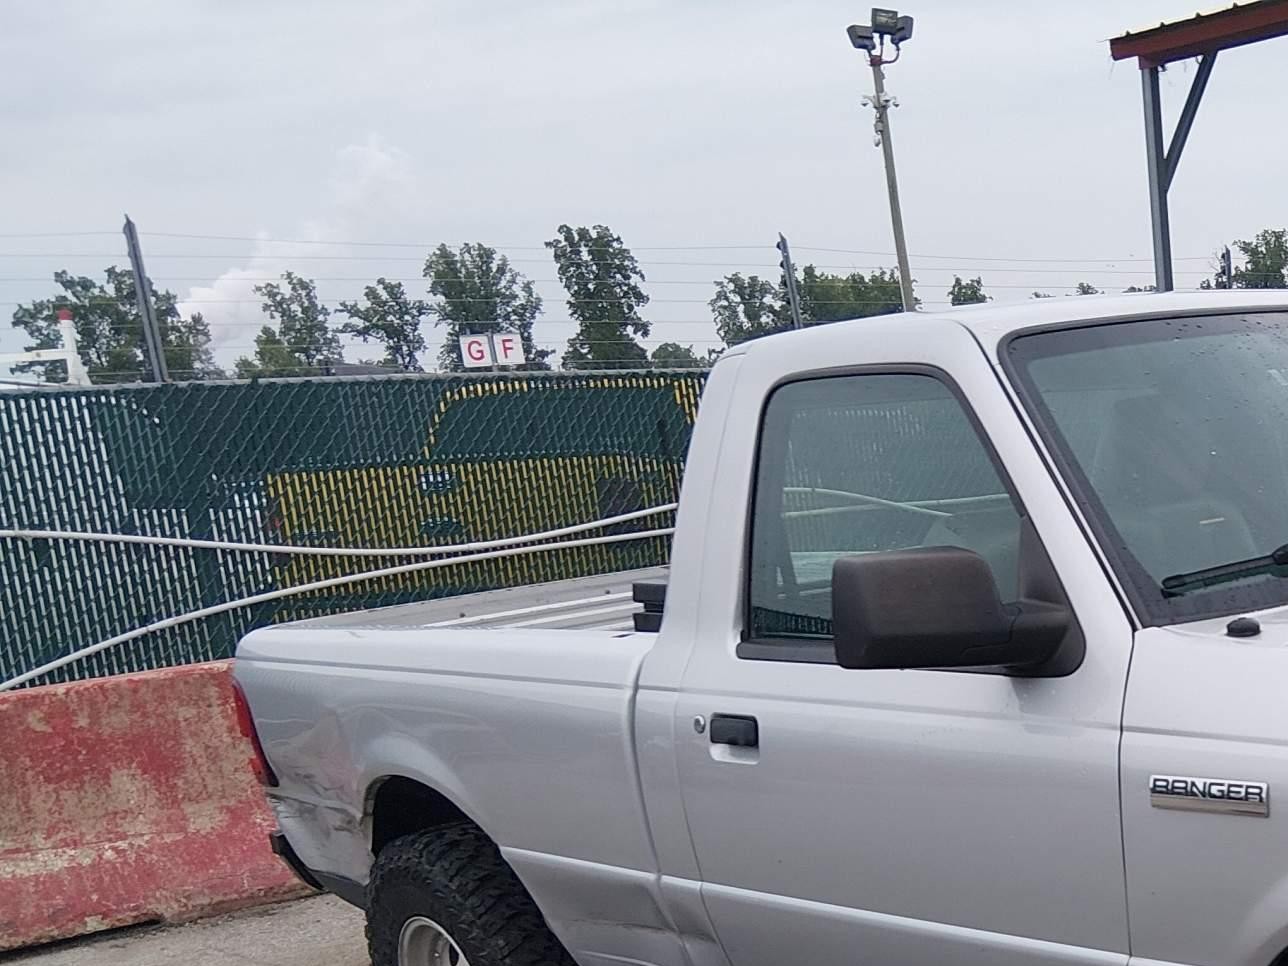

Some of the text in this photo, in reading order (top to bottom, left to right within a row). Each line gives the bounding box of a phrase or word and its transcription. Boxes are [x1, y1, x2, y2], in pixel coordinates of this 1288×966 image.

[467, 339, 486, 362] G
[501, 338, 515, 360] F
[1150, 777, 1265, 803] RANGER
